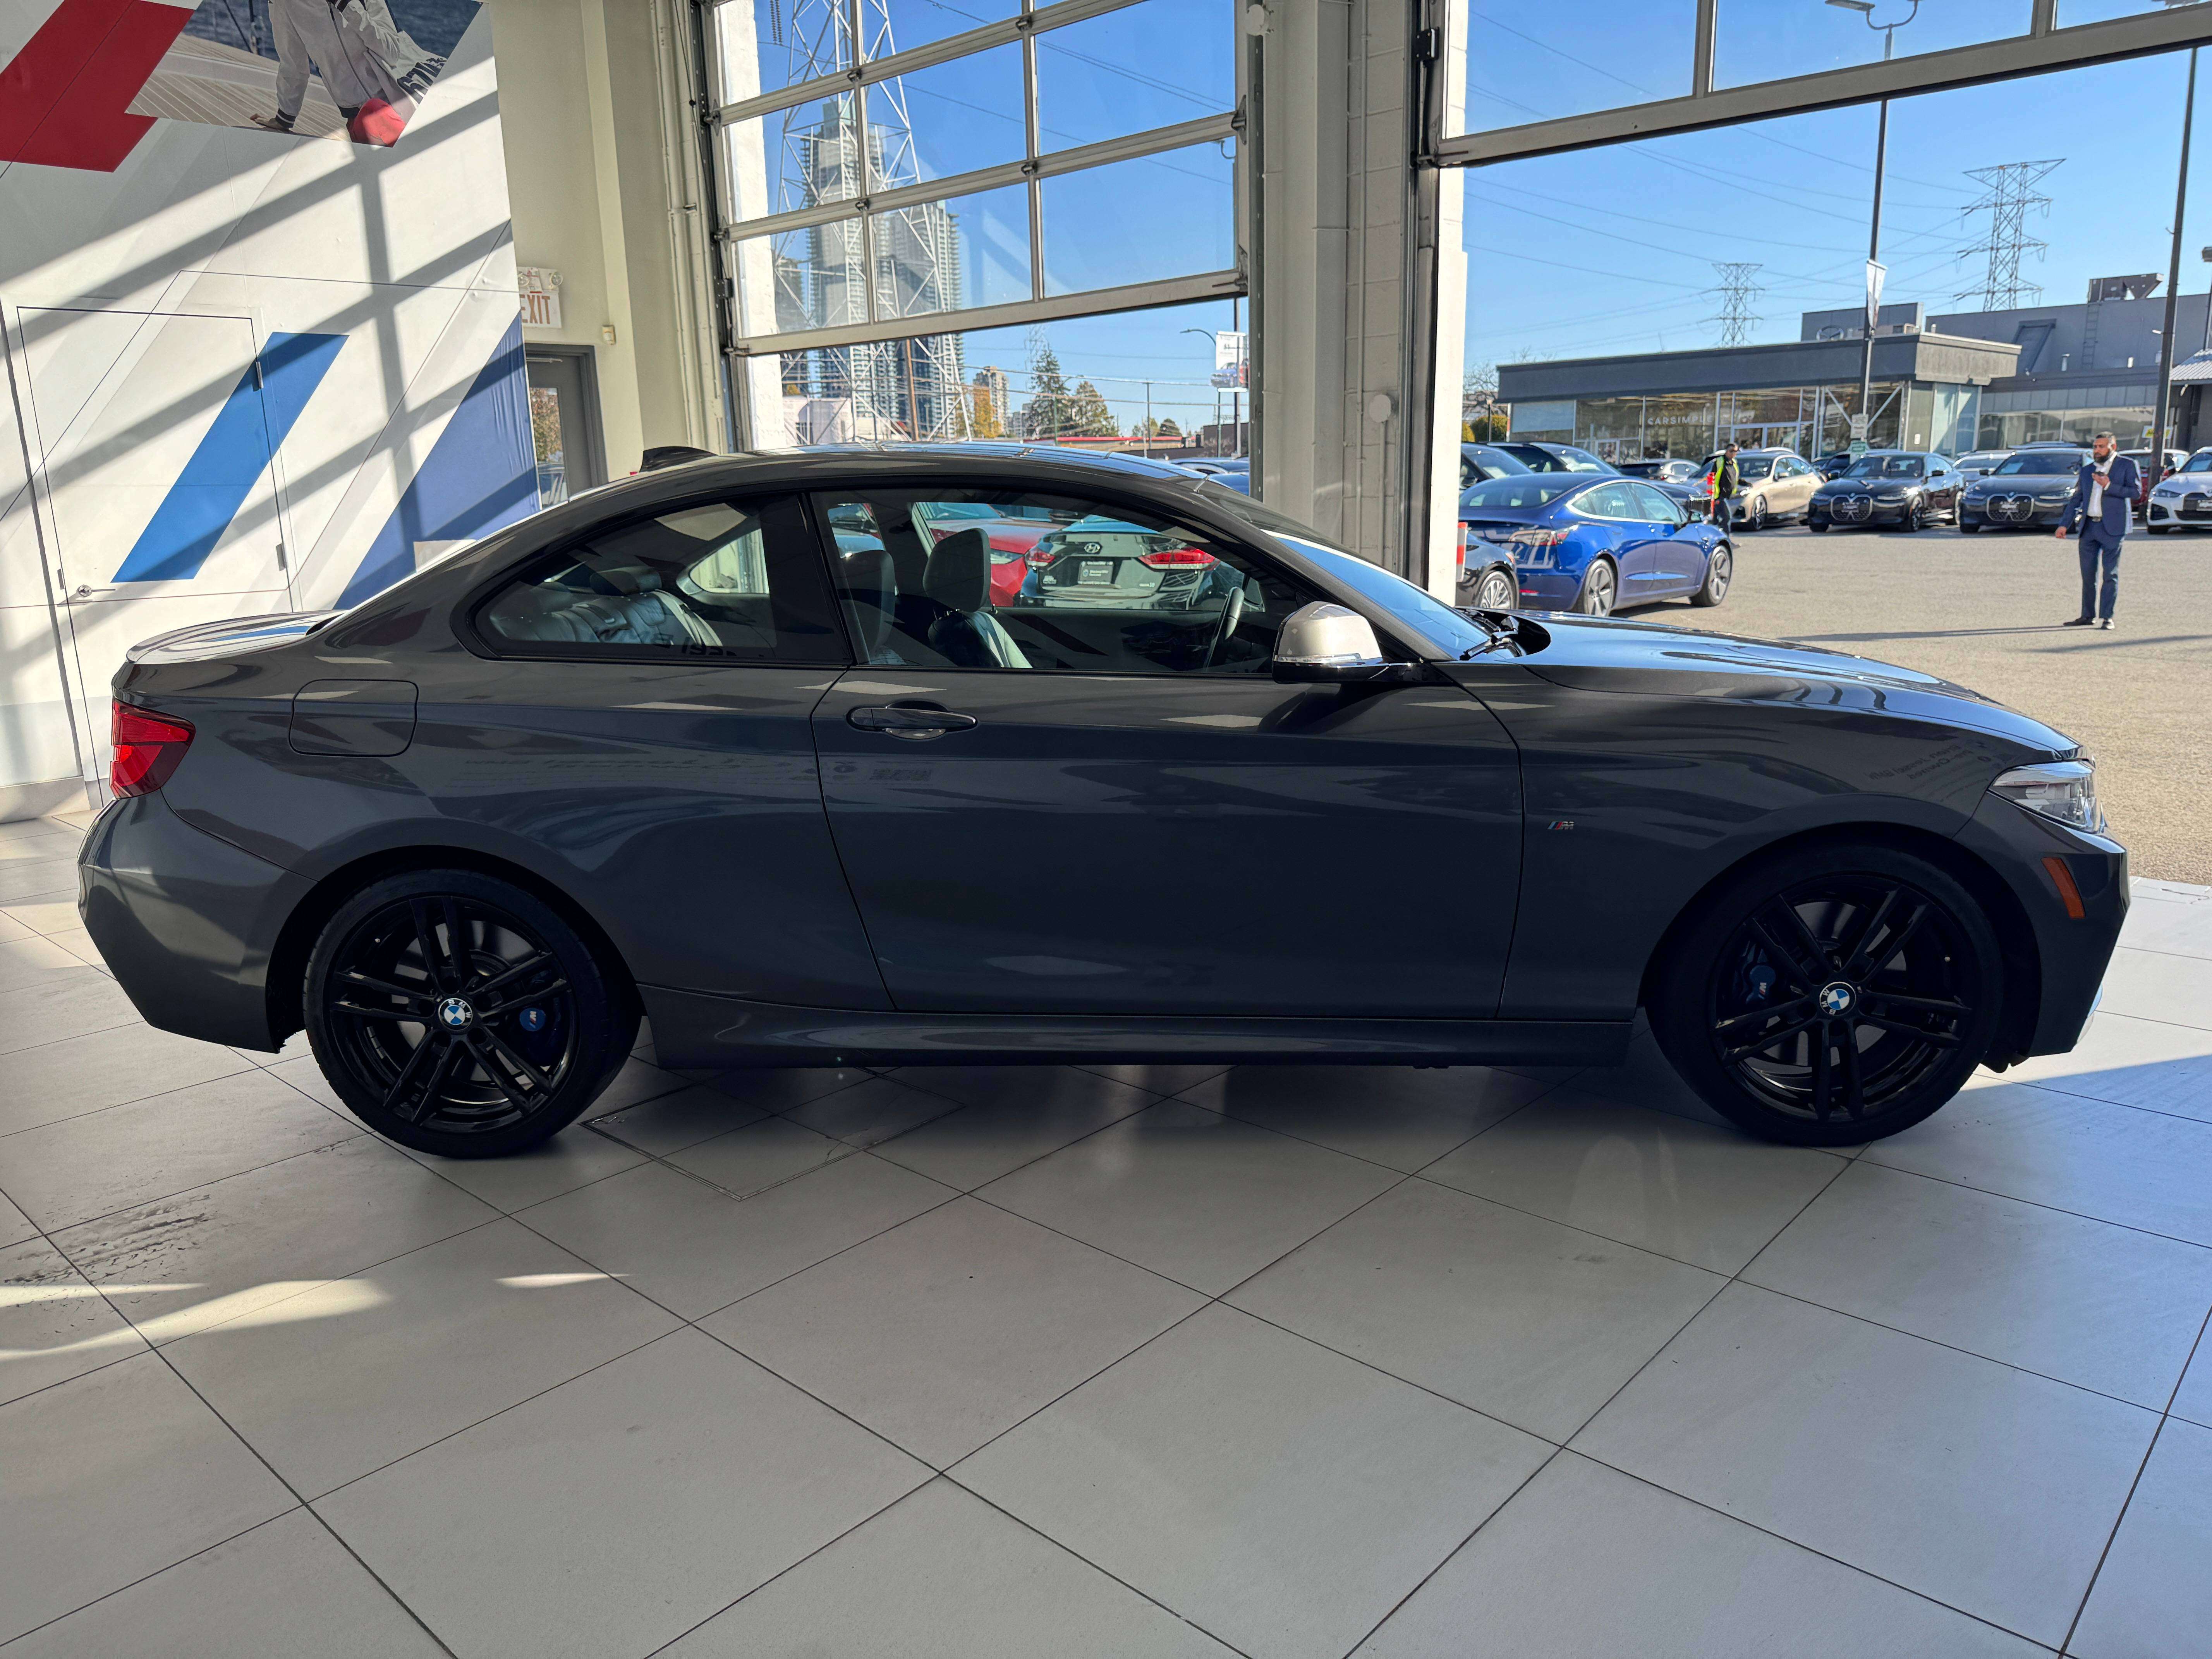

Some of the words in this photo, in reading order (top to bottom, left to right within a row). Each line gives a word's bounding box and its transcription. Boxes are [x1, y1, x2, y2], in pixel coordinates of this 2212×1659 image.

[1647, 414, 1712, 425] CARSIMPLE
[448, 999, 471, 1018] BMW
[1821, 989, 1836, 1015] BMW
